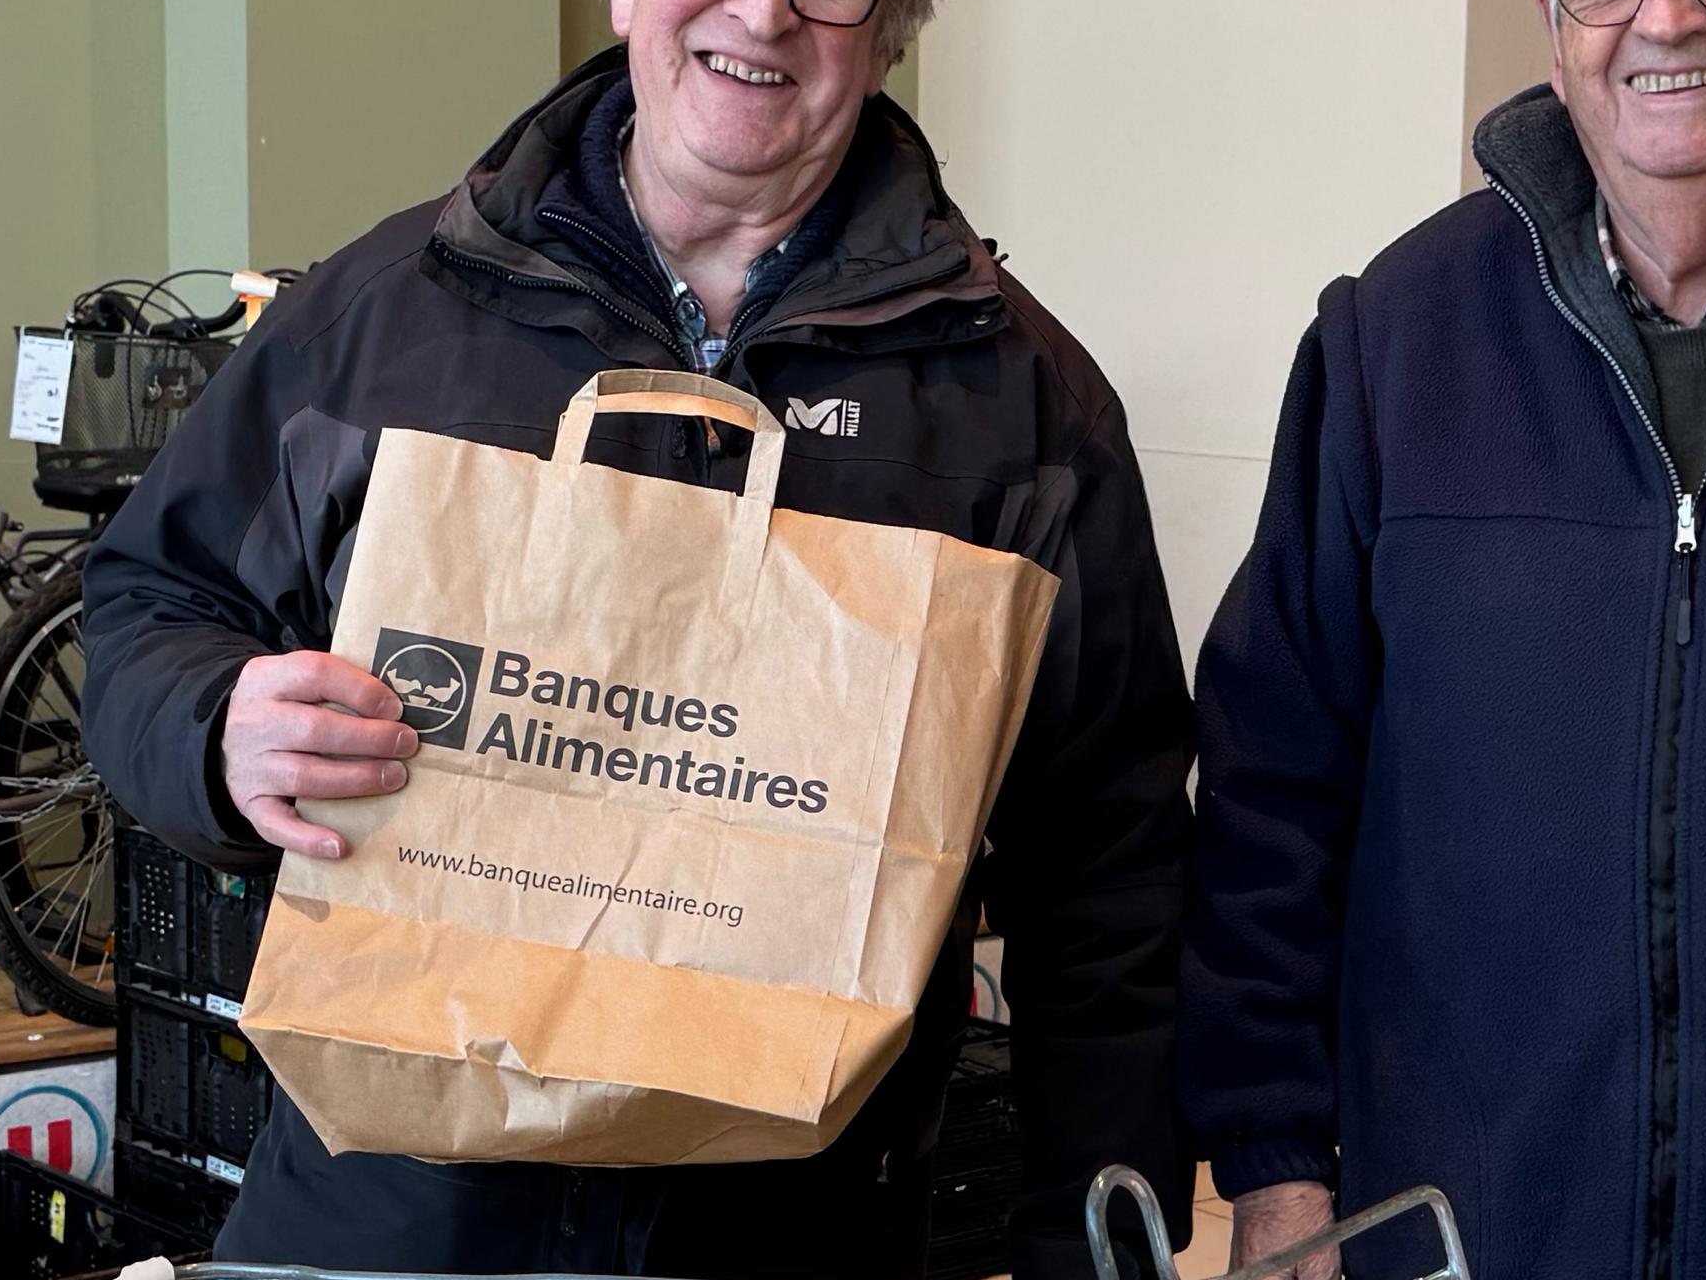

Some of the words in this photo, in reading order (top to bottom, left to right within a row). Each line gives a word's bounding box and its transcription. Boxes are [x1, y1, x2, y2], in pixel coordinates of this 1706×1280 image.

[846, 400, 860, 437] MILLET
[488, 650, 740, 739] Banques
[476, 713, 830, 816] Alimentaires
[397, 842, 745, 929] www.banquealimentaire.org
